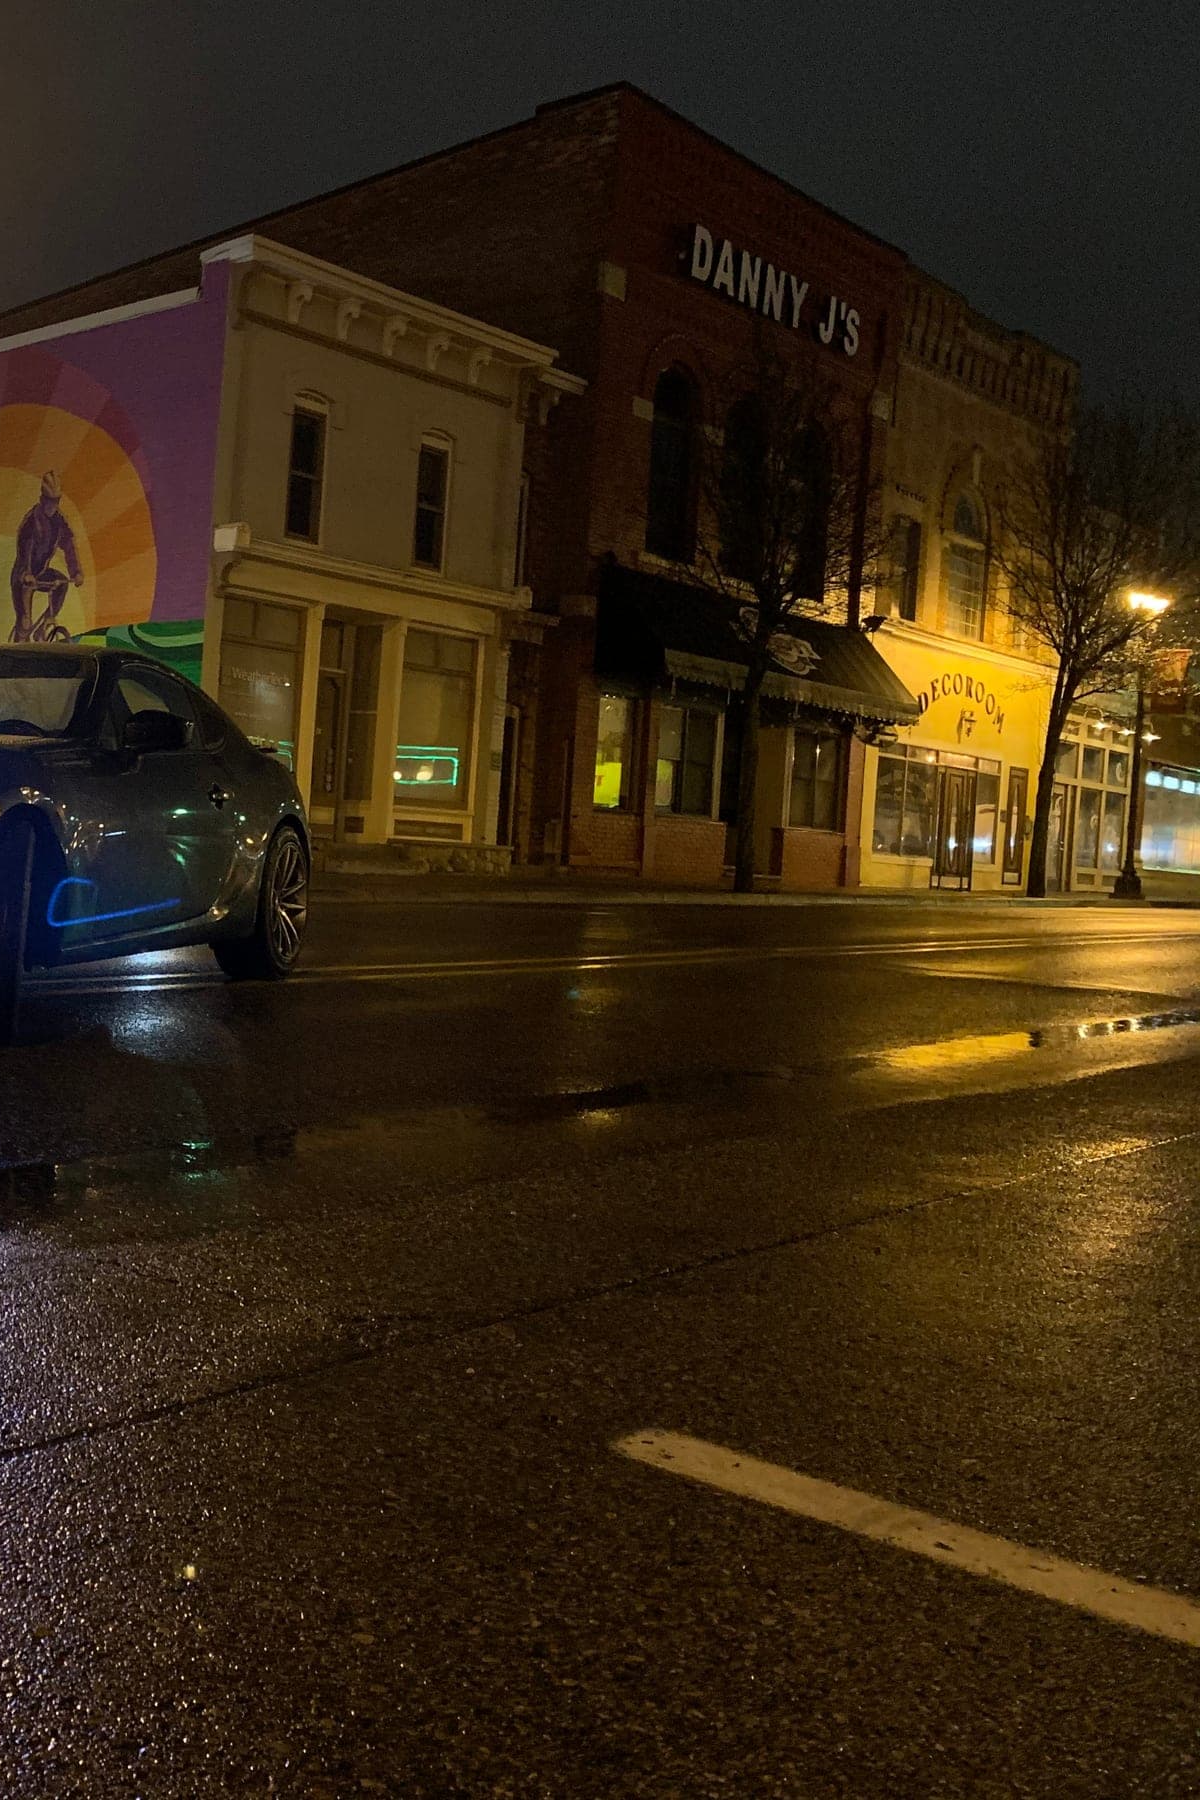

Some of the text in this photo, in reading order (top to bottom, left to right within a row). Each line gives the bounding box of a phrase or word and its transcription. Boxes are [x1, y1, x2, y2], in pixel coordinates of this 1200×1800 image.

[691, 223, 861, 357] DANNY J'S
[917, 672, 1005, 735] DECOROOM
